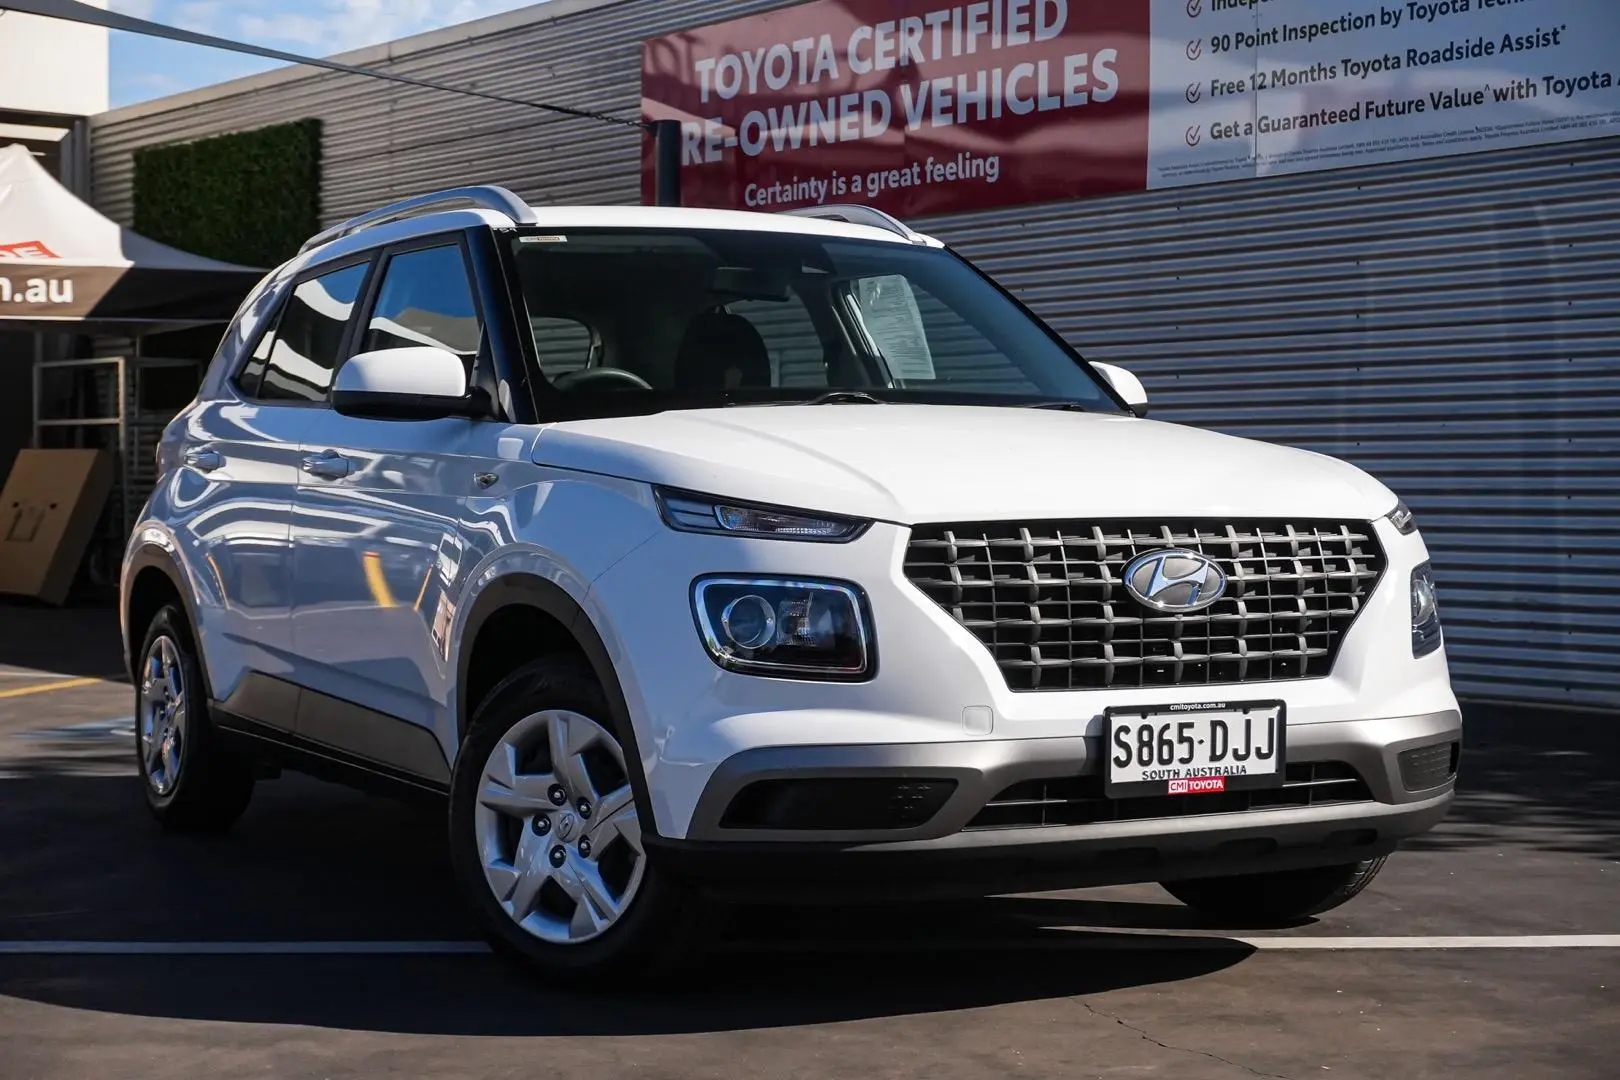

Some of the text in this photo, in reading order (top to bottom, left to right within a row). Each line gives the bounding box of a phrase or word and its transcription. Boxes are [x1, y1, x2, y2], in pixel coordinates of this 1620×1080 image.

[695, 0, 1068, 104] TOYOTA CERTIFIED
[1211, 34, 1231, 53] 90
[1235, 27, 1279, 50] Point
[1282, 11, 1376, 43] Inspection
[1380, 6, 1403, 28] by
[1406, 0, 1470, 23] Toyota
[1210, 78, 1245, 97] Free
[1249, 71, 1267, 91] 12
[1271, 62, 1337, 89] Months
[1341, 52, 1401, 79] Toyota
[1406, 36, 1495, 67] Roadside
[681, 48, 1119, 167] RE-OWNED VEHICLES
[1210, 121, 1241, 140] Get
[1243, 122, 1253, 136] a
[1257, 102, 1360, 134] Guaranteed
[1365, 97, 1425, 120] Future
[1493, 78, 1537, 102] with
[1542, 70, 1612, 98] Toyota
[744, 152, 1000, 207] Certainty is a great feeling
[1169, 702, 1226, 712] cmitoyota.com.au
[1141, 764, 1248, 781] SOUTH AUSTRALIA
[1188, 778, 1224, 790] TOYOTA
